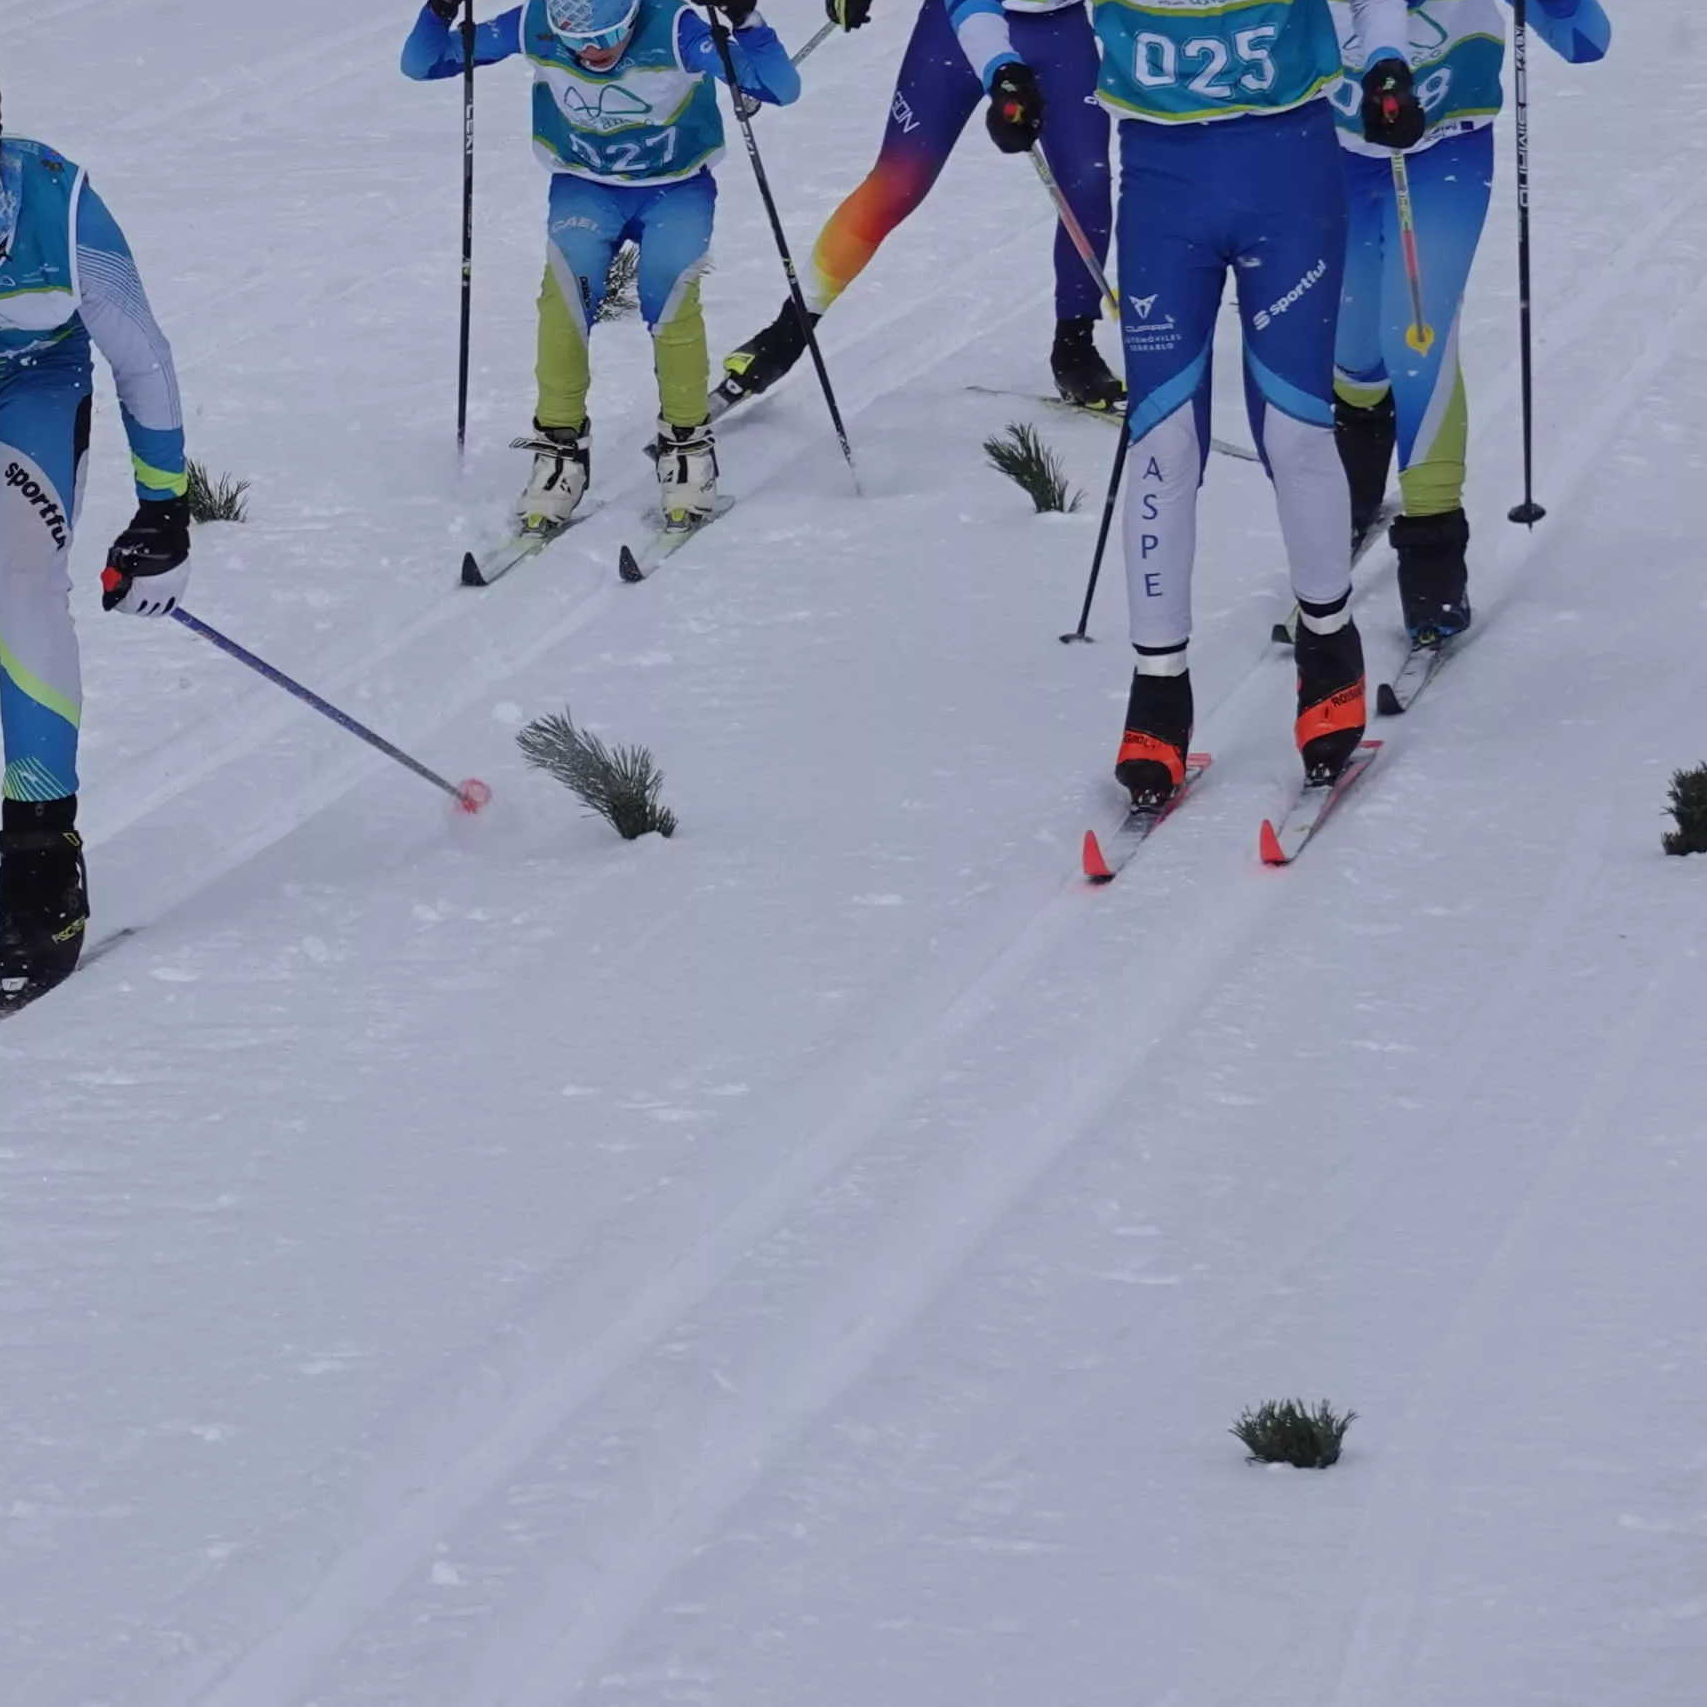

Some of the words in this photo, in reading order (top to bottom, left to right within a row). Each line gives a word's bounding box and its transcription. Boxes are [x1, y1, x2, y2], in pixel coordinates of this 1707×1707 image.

[1134, 23, 1277, 99] 025
[1269, 258, 1328, 317] sportful
[4, 461, 68, 551] sportfu
